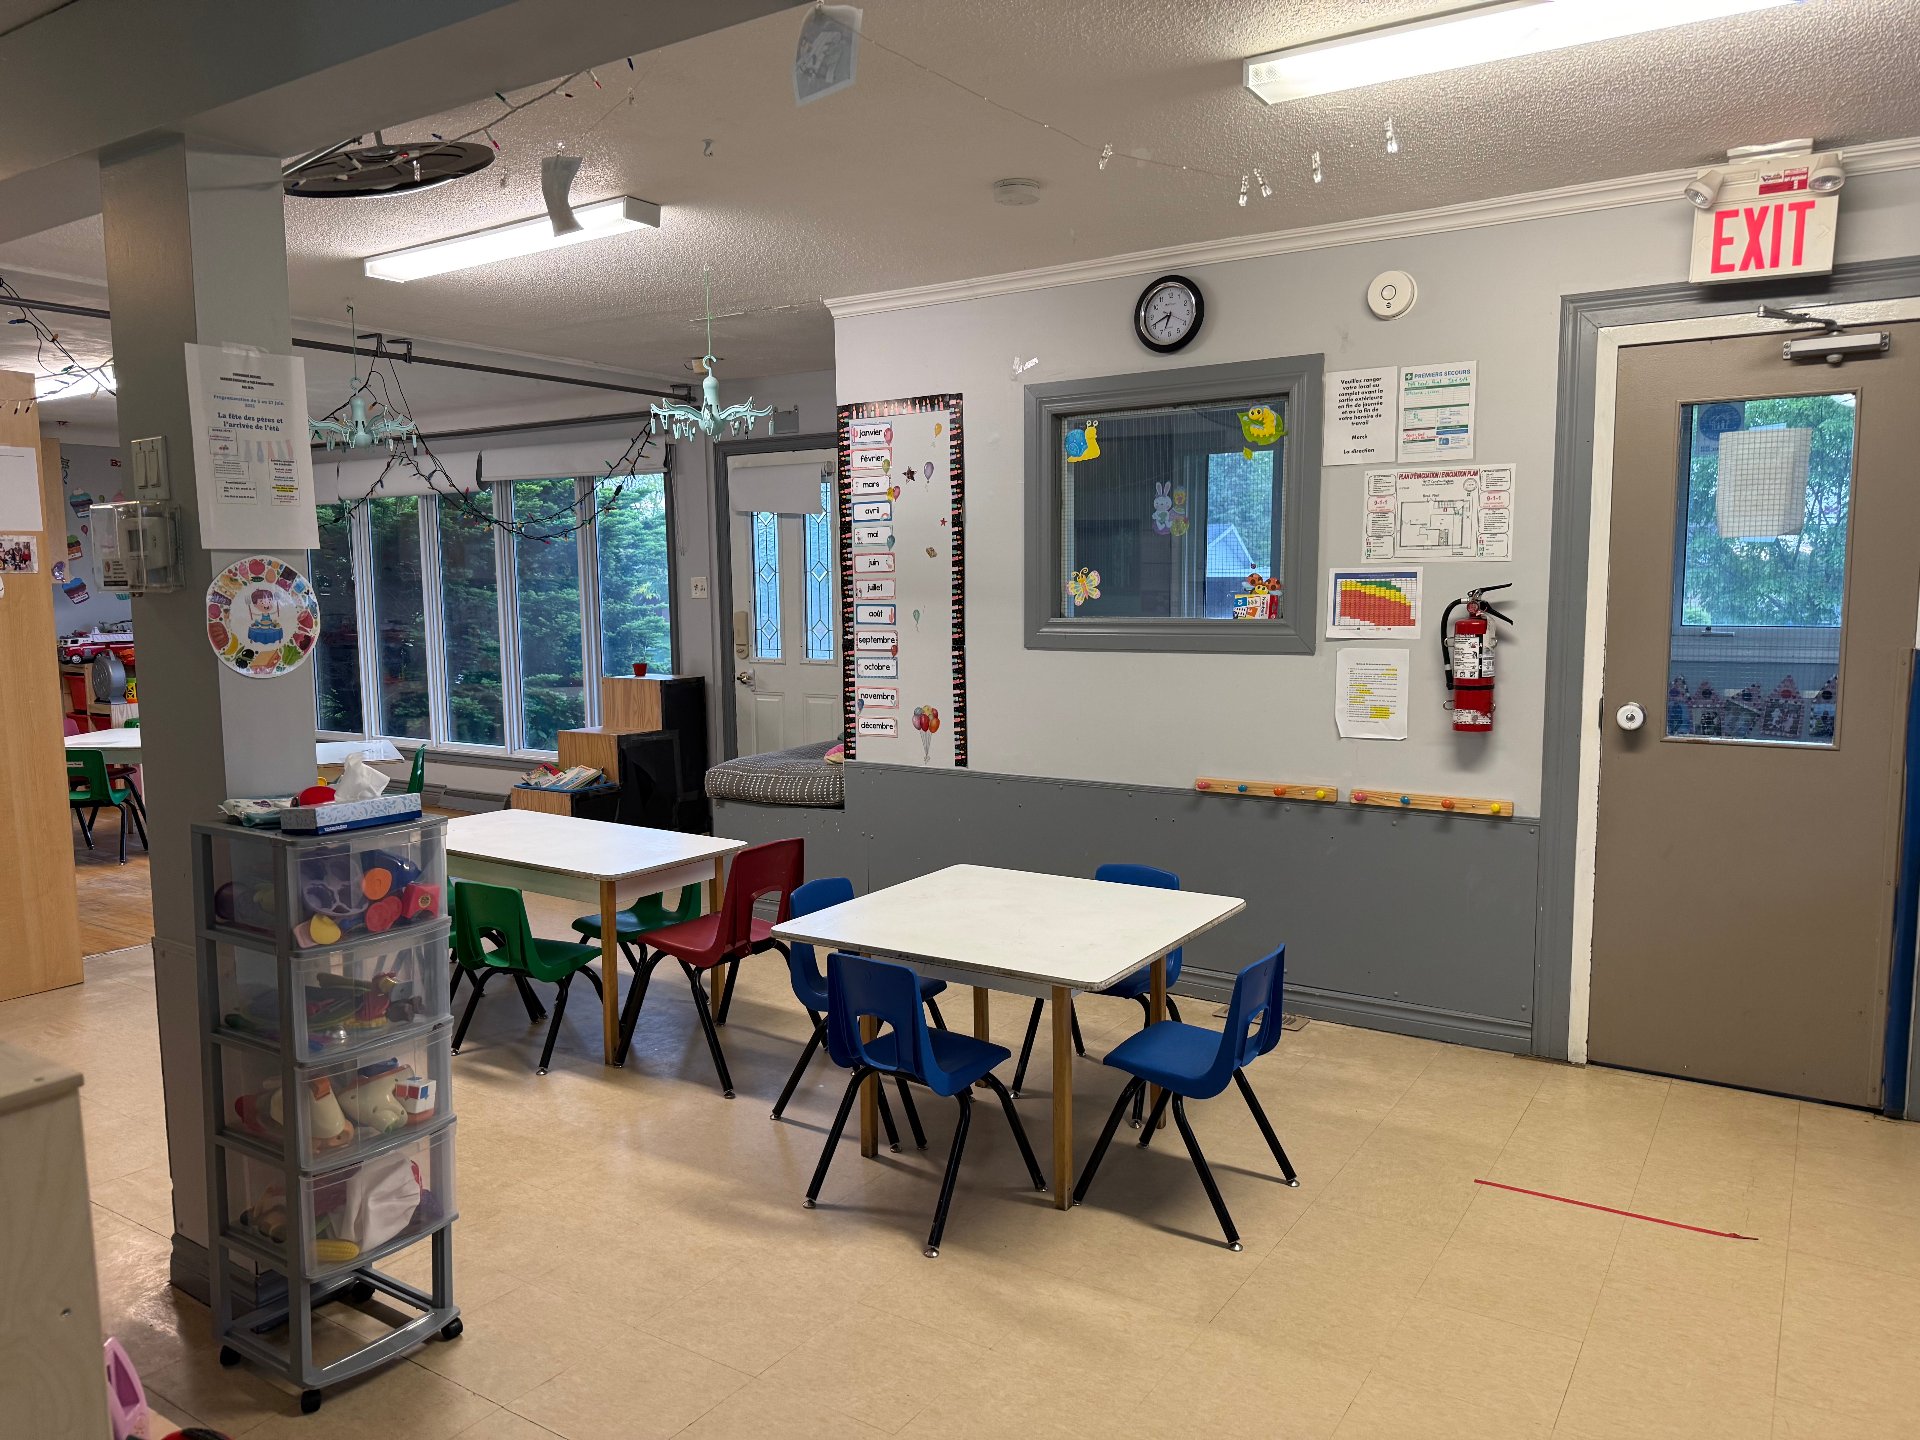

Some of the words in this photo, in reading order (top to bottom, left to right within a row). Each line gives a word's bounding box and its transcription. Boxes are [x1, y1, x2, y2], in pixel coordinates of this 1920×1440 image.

[1710, 200, 1816, 274] EXIT
[223, 421, 253, 430] l'arrivée
[859, 428, 882, 438] janvier
[860, 454, 884, 463] février
[868, 559, 880, 568] juin
[867, 584, 883, 592] juillet
[868, 609, 883, 617] août
[858, 636, 895, 646] septembre
[860, 692, 895, 701] novembre
[860, 722, 894, 730] décembre
